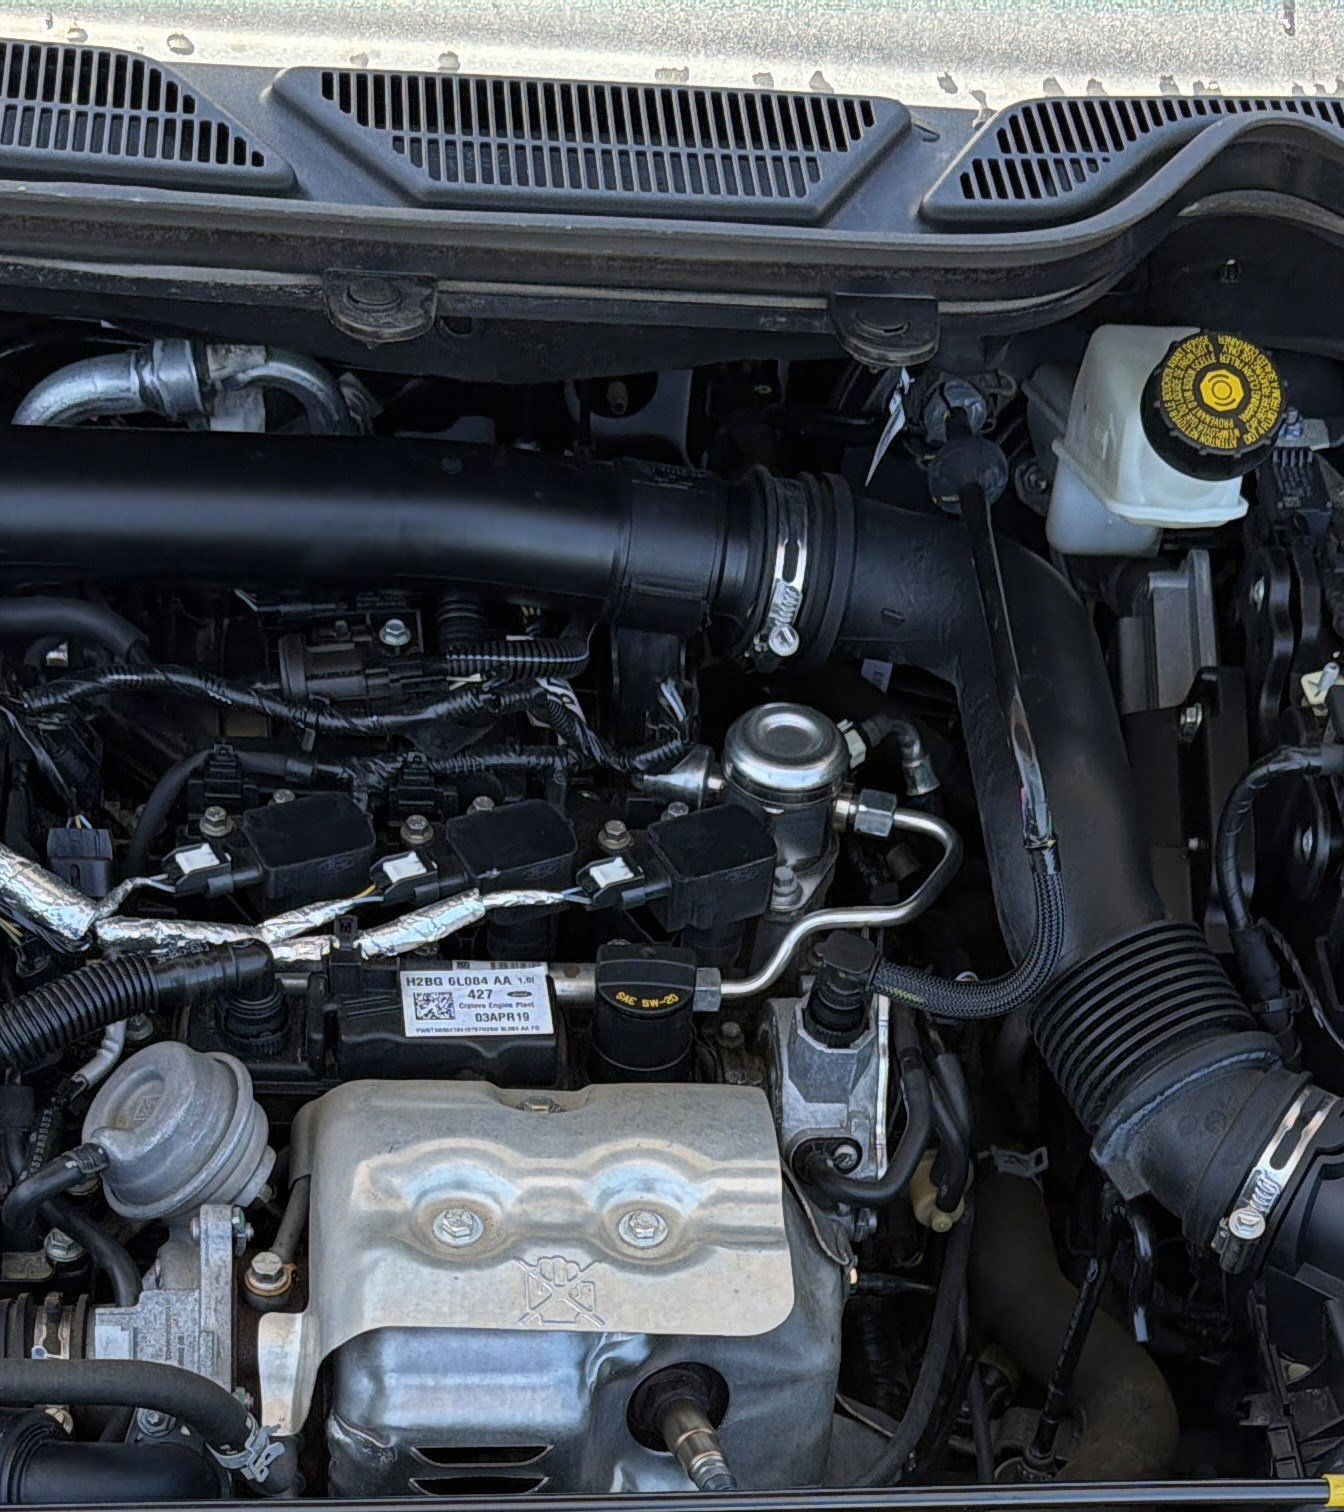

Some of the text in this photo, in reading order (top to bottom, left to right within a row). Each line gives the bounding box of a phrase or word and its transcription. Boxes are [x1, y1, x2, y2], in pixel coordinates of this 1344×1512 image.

[406, 976, 444, 987] H2BG
[493, 975, 512, 986] AA
[467, 988, 494, 1000] 427
[615, 991, 680, 1008] SAE 5W-20
[488, 1001, 514, 1010] Engine
[515, 1001, 535, 1009] Plant
[475, 1011, 530, 1023] 03APR19
